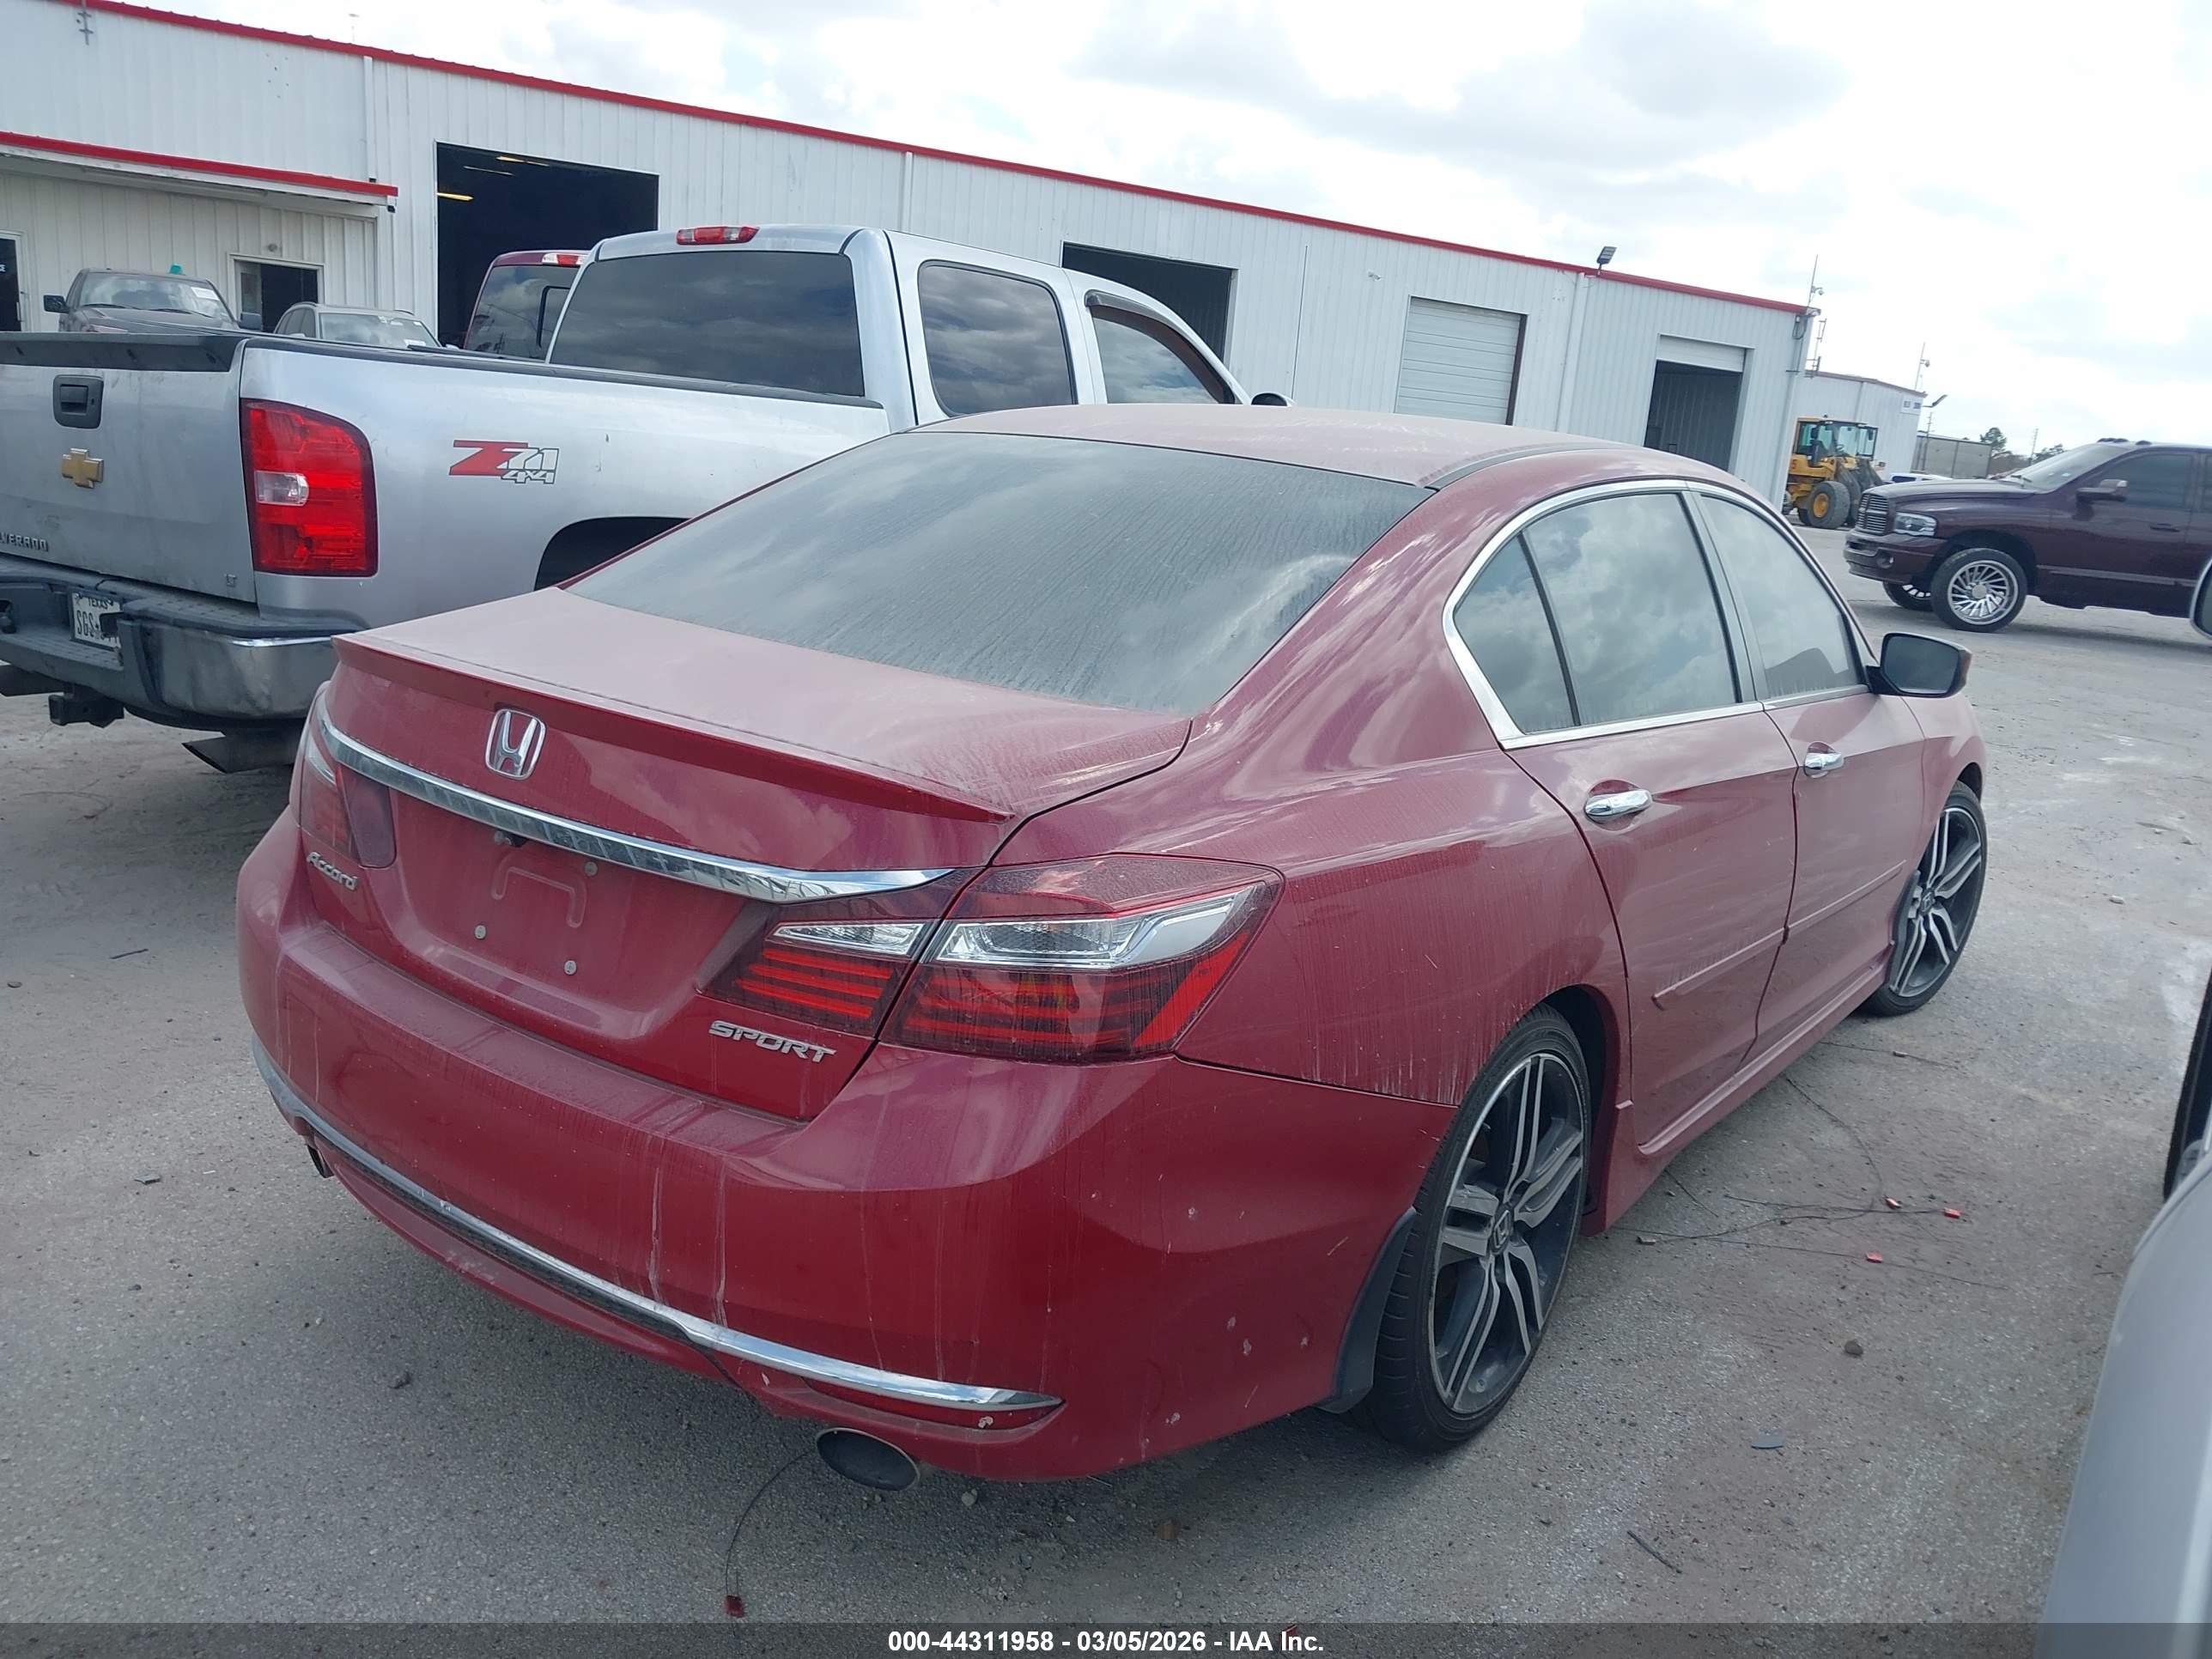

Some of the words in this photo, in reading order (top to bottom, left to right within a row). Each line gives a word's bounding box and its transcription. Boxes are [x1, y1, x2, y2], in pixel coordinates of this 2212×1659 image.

[449, 440, 559, 476] Z71
[307, 851, 358, 890] Accord
[708, 1020, 837, 1063] SPORT
